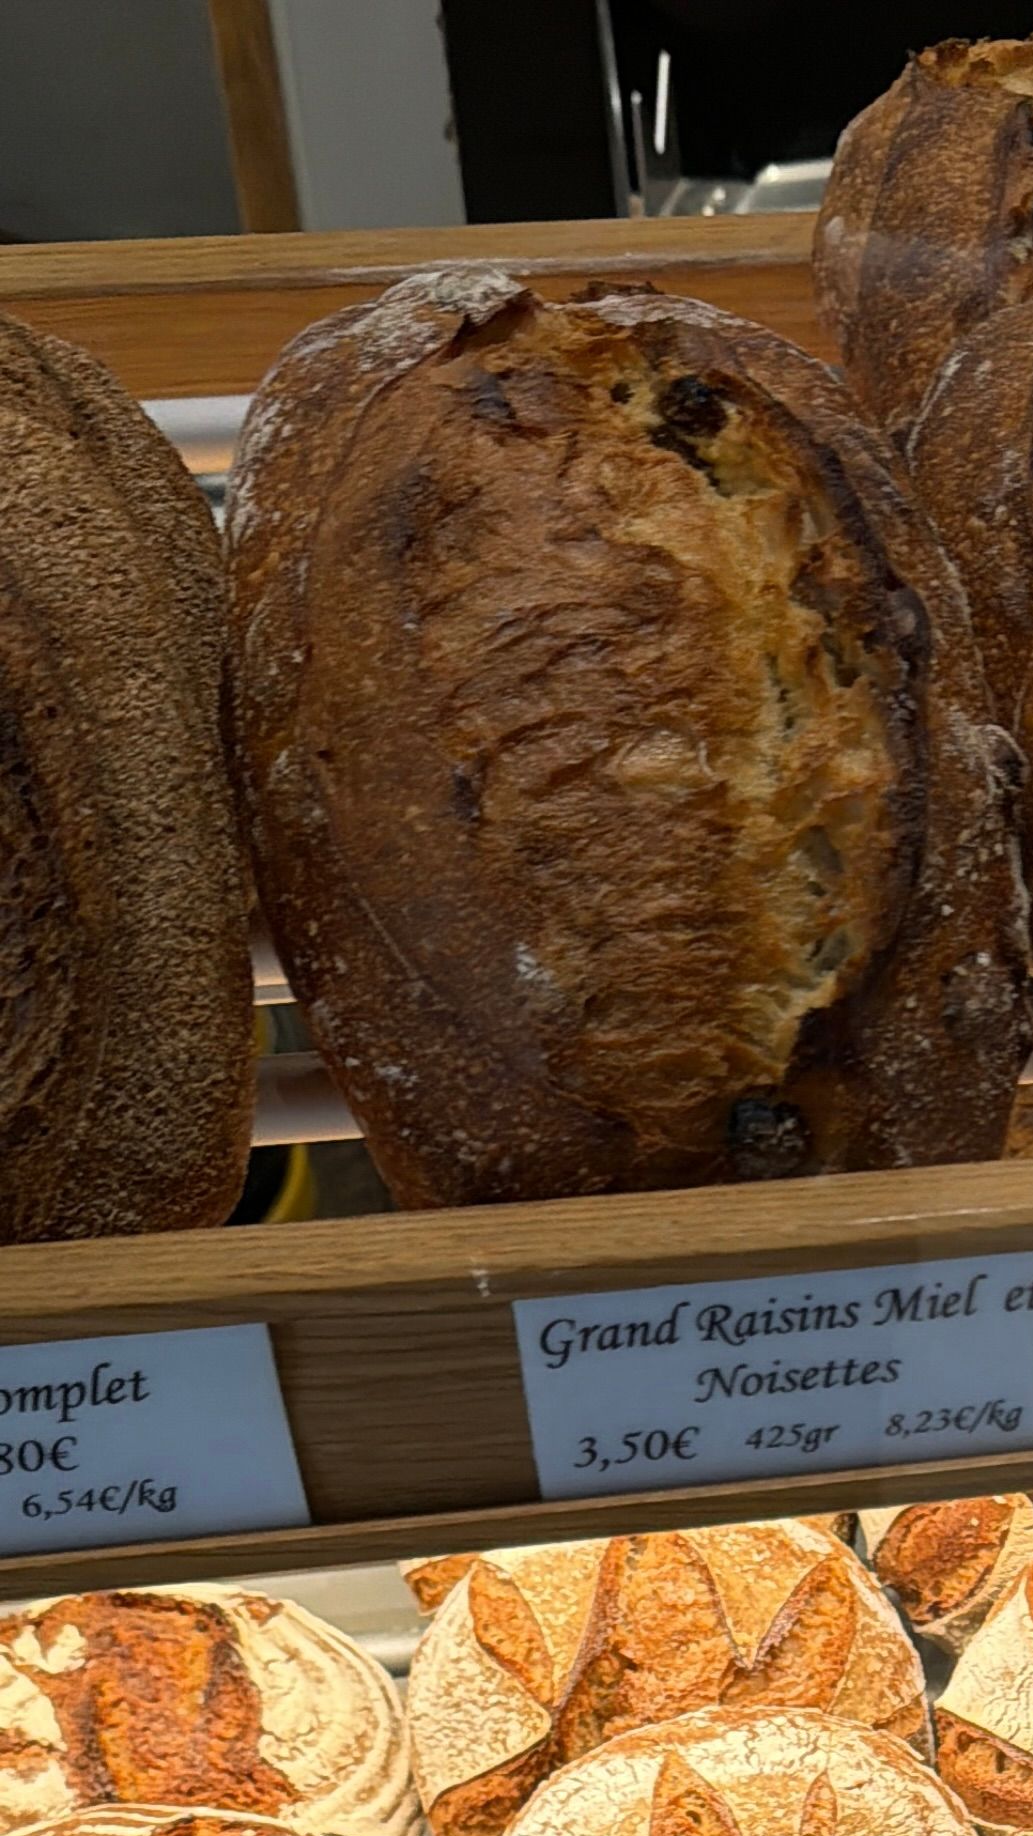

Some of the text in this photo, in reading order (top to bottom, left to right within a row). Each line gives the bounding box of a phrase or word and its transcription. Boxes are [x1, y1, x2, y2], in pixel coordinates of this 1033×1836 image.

[539, 1301, 692, 1370] Grand
[695, 1298, 862, 1347] Raisins
[873, 1274, 989, 1326] Miel
[694, 1357, 903, 1404] Noisettes
[573, 1398, 1024, 1473] 3,50€ 425gr 8,23€/kg
[22, 1478, 179, 1521] 6,54€/kg
